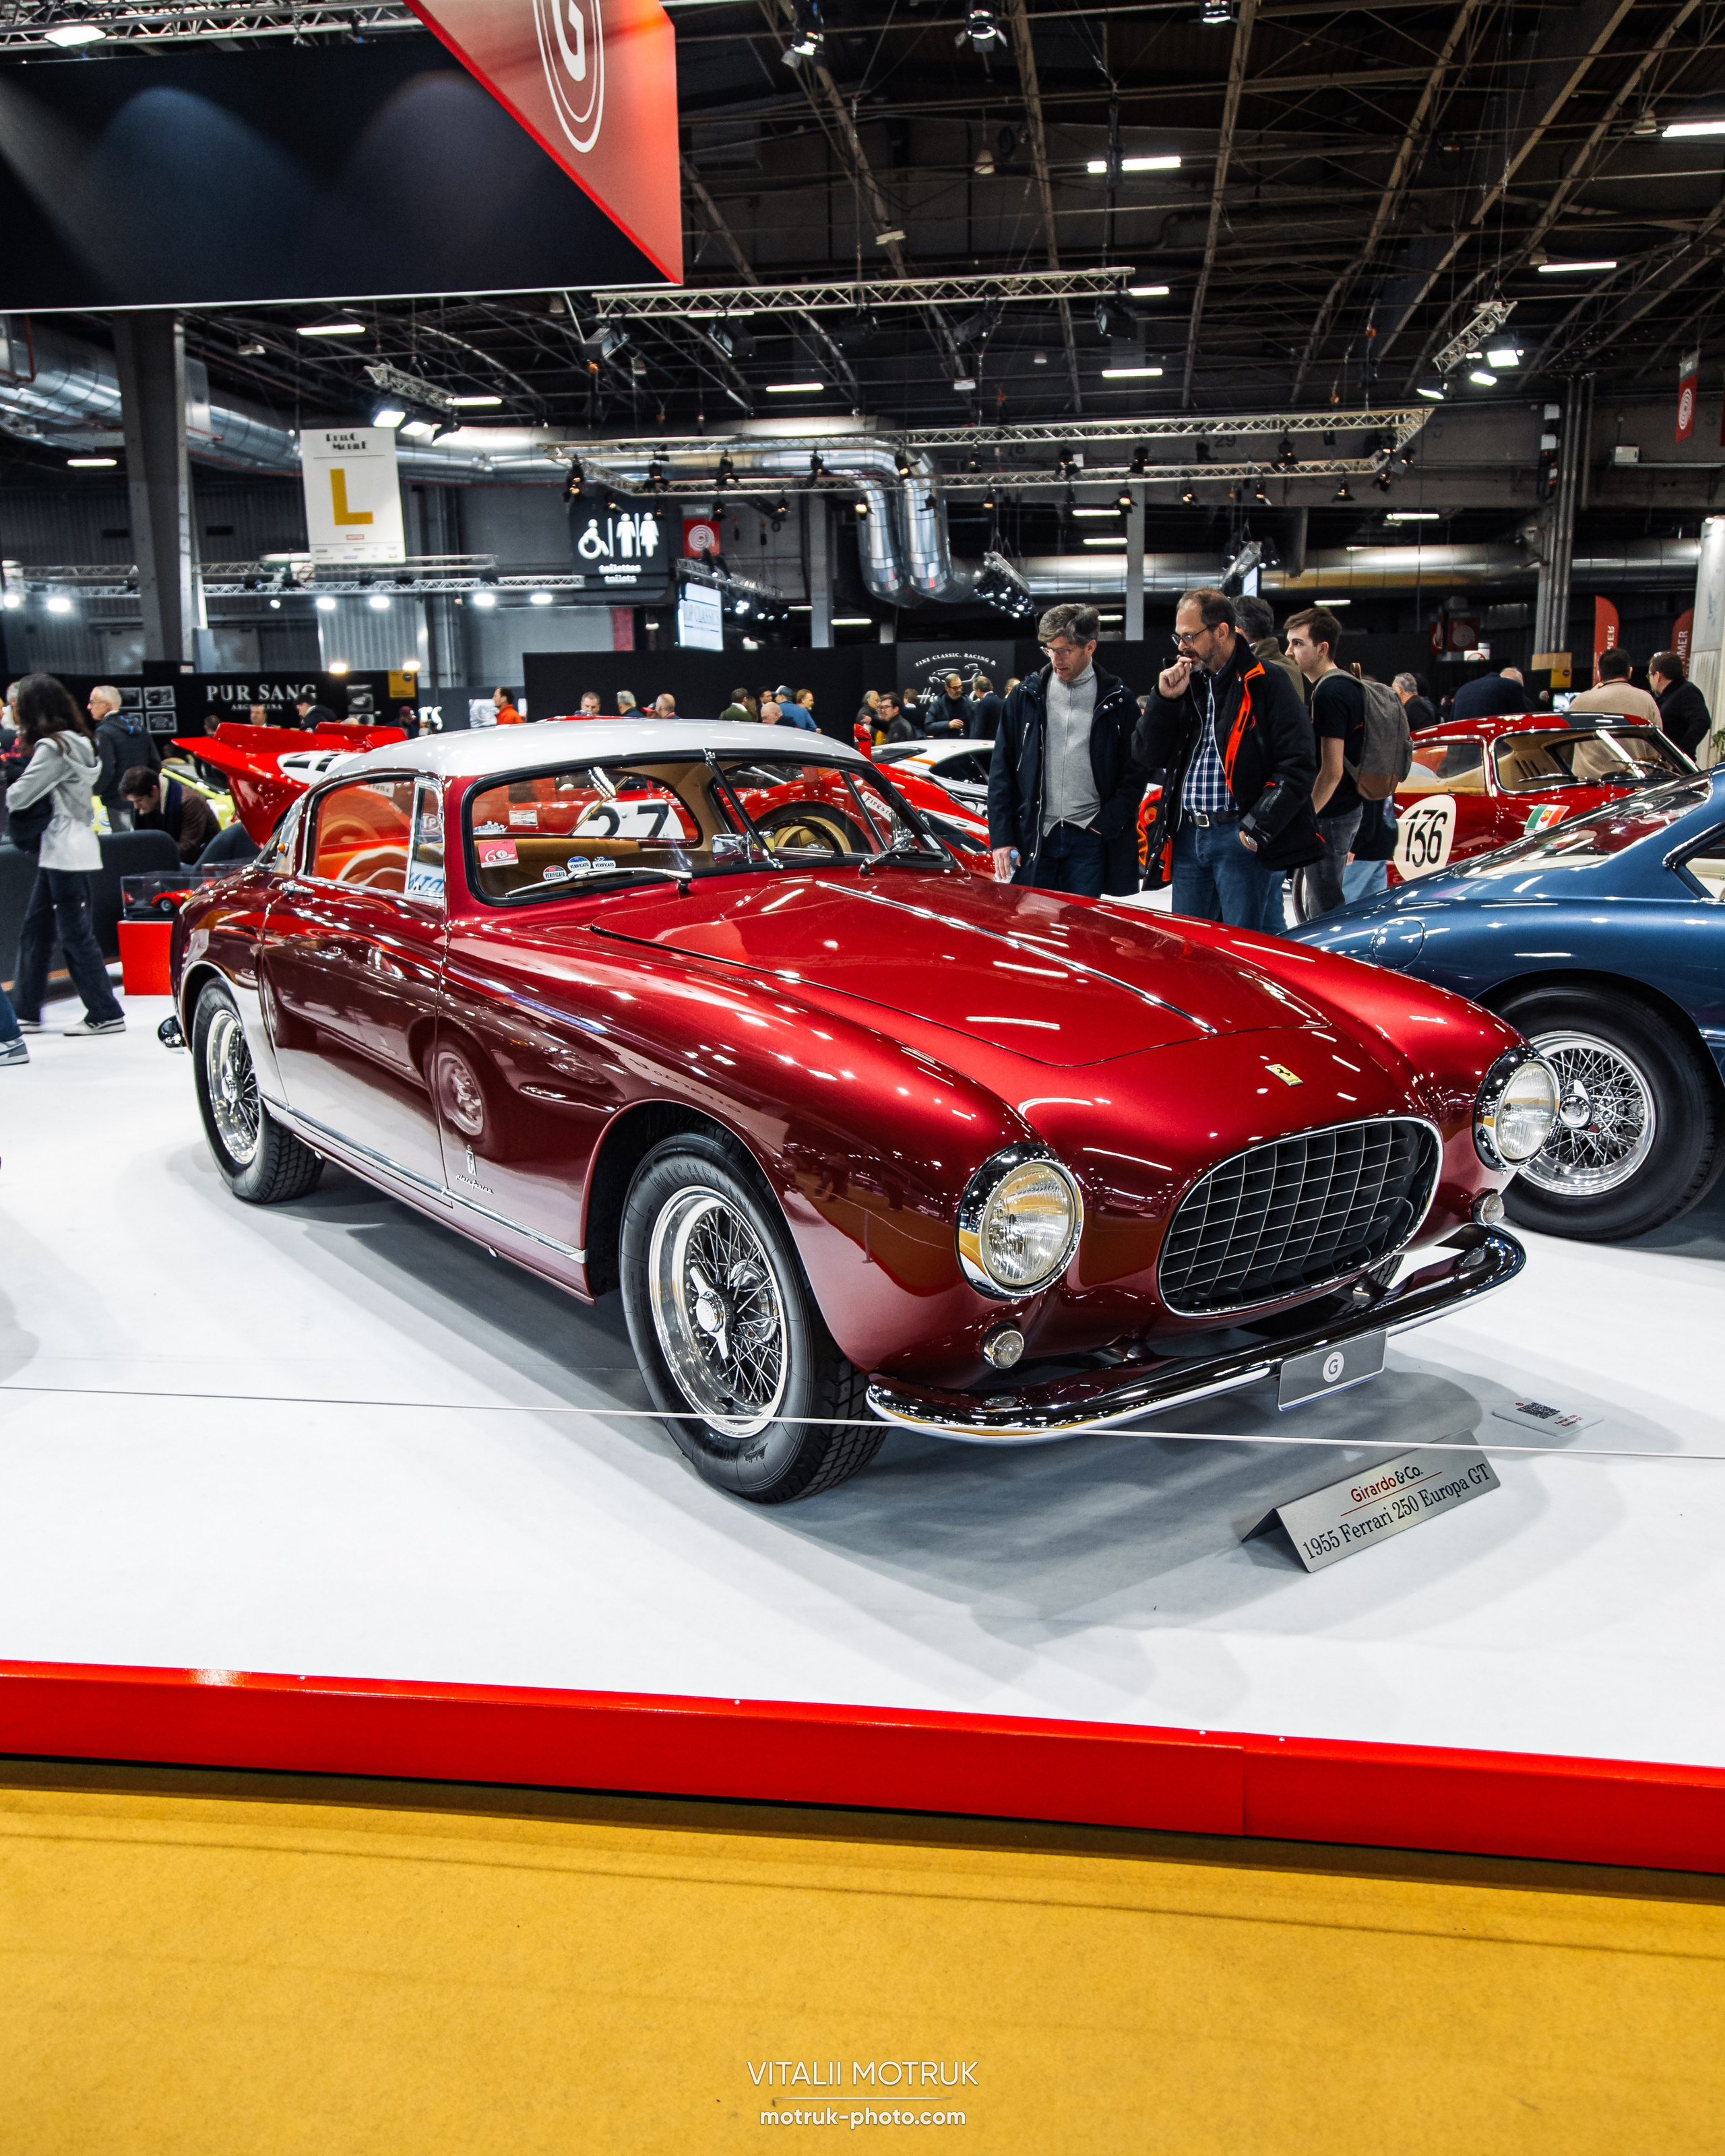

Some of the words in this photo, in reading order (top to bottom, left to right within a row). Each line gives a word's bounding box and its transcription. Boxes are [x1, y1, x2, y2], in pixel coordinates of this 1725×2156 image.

[330, 468, 373, 526] L
[598, 563, 641, 574] toilettes
[604, 575, 637, 584] toilets
[915, 657, 931, 667] FINE
[964, 653, 989, 663] RACING
[206, 685, 251, 701] PUR
[258, 684, 317, 700] SANG
[586, 802, 669, 837] 27
[1405, 808, 1448, 868] 136
[1328, 1358, 1339, 1375] G
[1303, 1529, 1340, 1559] 1955
[1338, 1509, 1394, 1543] Ferrari
[1392, 1495, 1419, 1519] 250
[1418, 1478, 1470, 1508] Europa
[1468, 1463, 1491, 1484] GT
